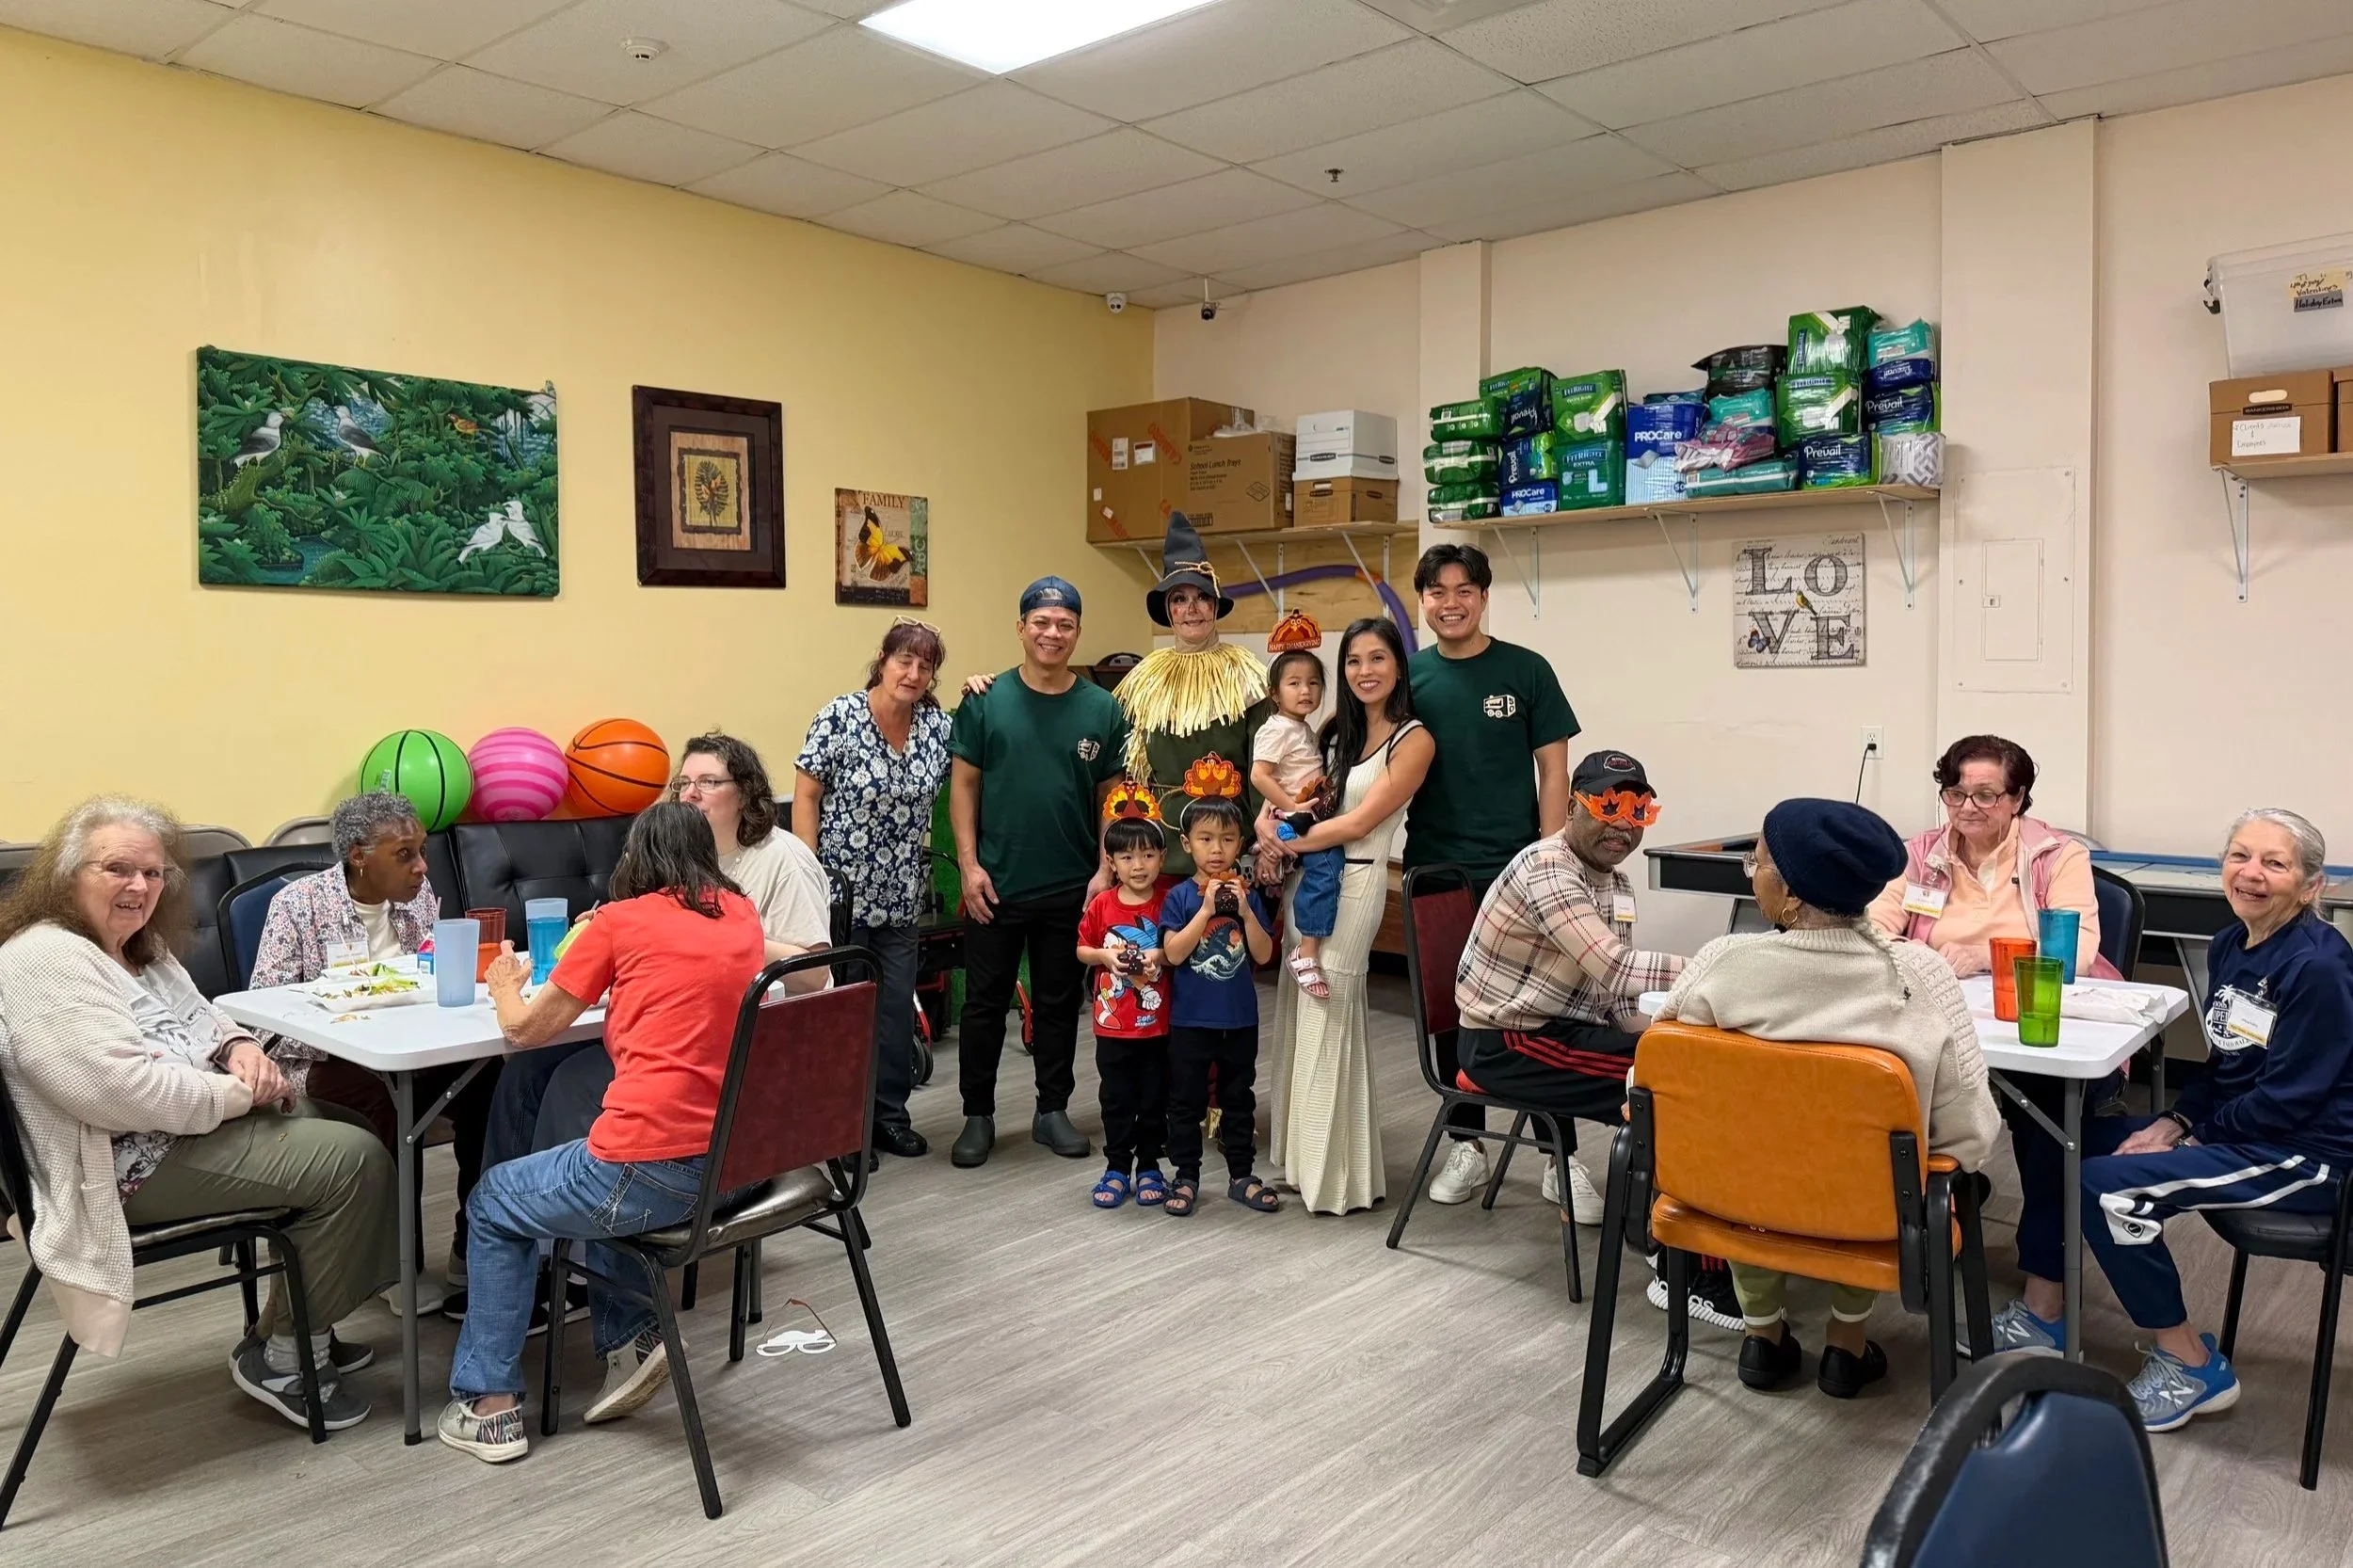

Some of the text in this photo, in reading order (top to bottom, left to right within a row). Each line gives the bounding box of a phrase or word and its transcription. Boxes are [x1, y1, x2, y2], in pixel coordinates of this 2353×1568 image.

[1865, 395, 1903, 412] Prevail
[1634, 430, 1683, 442] PROCare
[1804, 444, 1842, 458] Prevail
[1507, 450, 1518, 484] Prevail
[1588, 469, 1609, 493] L
[862, 492, 905, 508] FAMILY
[1511, 488, 1545, 500] PROCare
